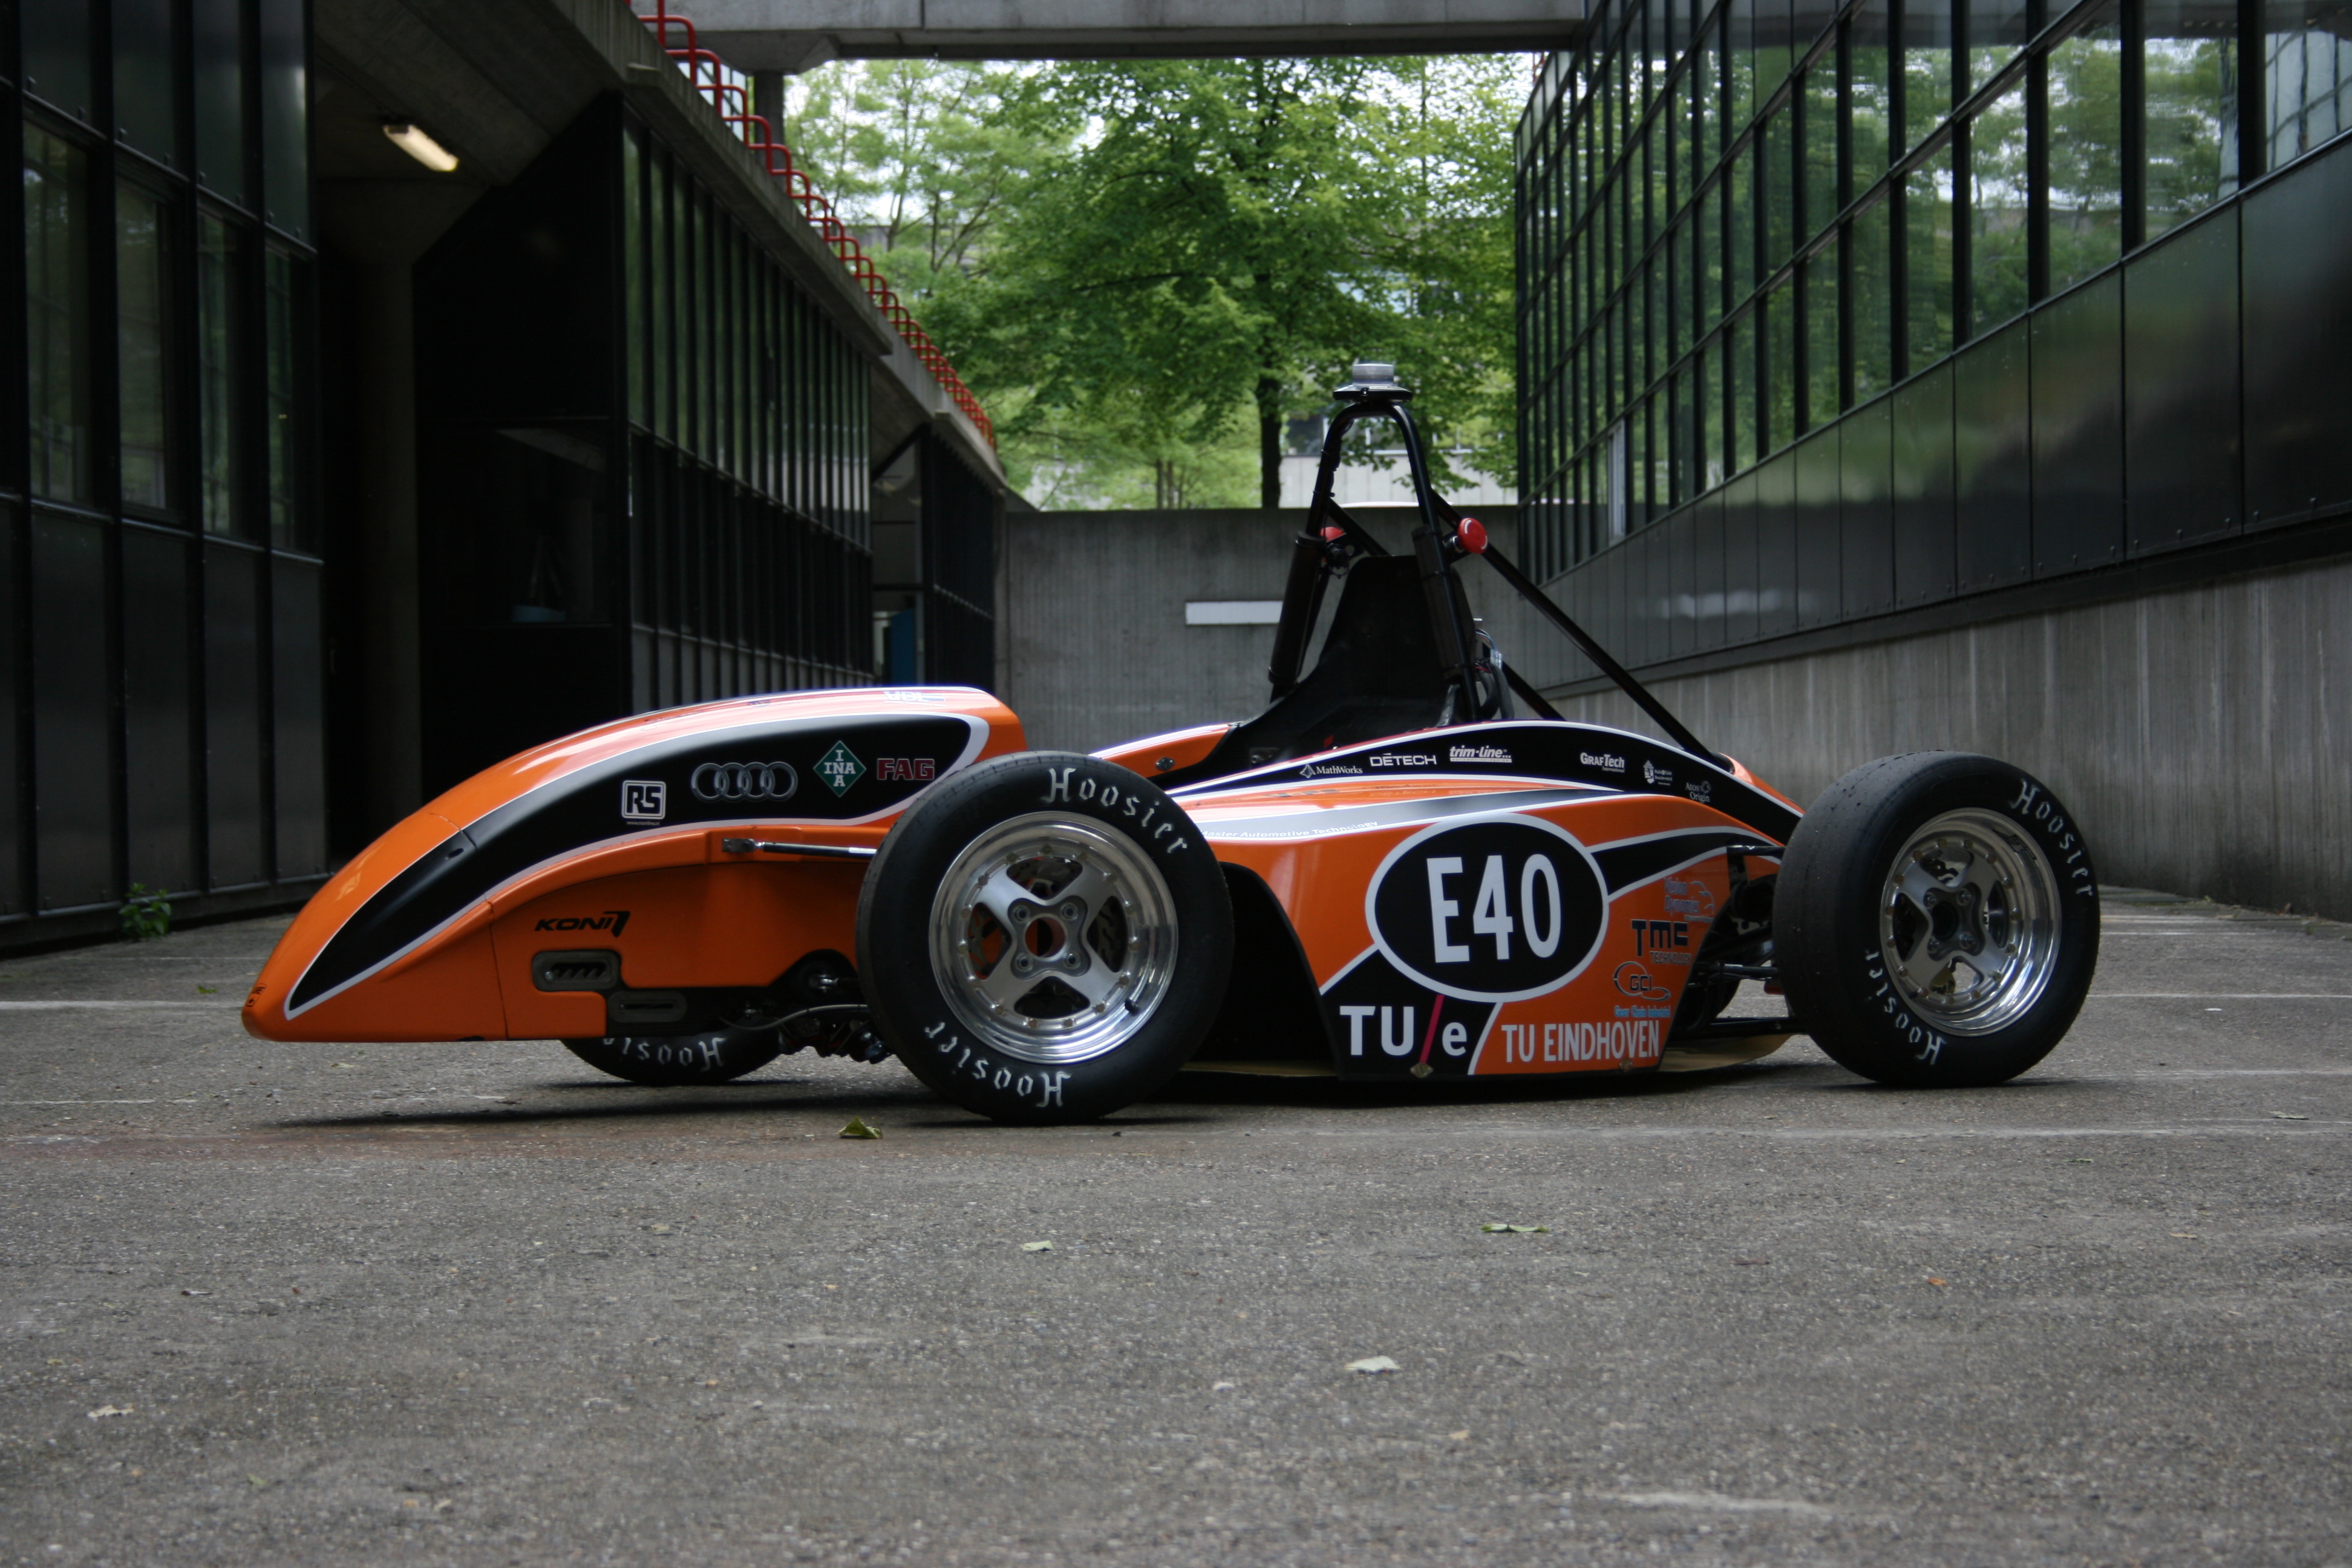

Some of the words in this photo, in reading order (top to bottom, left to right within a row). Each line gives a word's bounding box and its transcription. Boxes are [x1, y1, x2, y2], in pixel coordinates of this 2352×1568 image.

[877, 758, 935, 780] FAG
[1316, 765, 1363, 774] MathWorks
[626, 784, 662, 814] RS
[1040, 767, 1187, 854] Hoosier
[1690, 791, 1710, 803] Origin
[1311, 821, 1378, 835] Technology
[2009, 778, 2094, 897] Hoosier
[1427, 854, 1561, 963] E40
[534, 917, 615, 932] KONI
[1649, 951, 1692, 965] TECHNOLOGY
[1630, 974, 1653, 991] GCI
[1864, 947, 1947, 1065] Hoosier
[603, 1037, 727, 1072] Hoosi
[1501, 1024, 1535, 1063] TU
[1543, 1020, 1659, 1062] EINDHOVEN
[924, 1021, 1072, 1108] Hoosier
